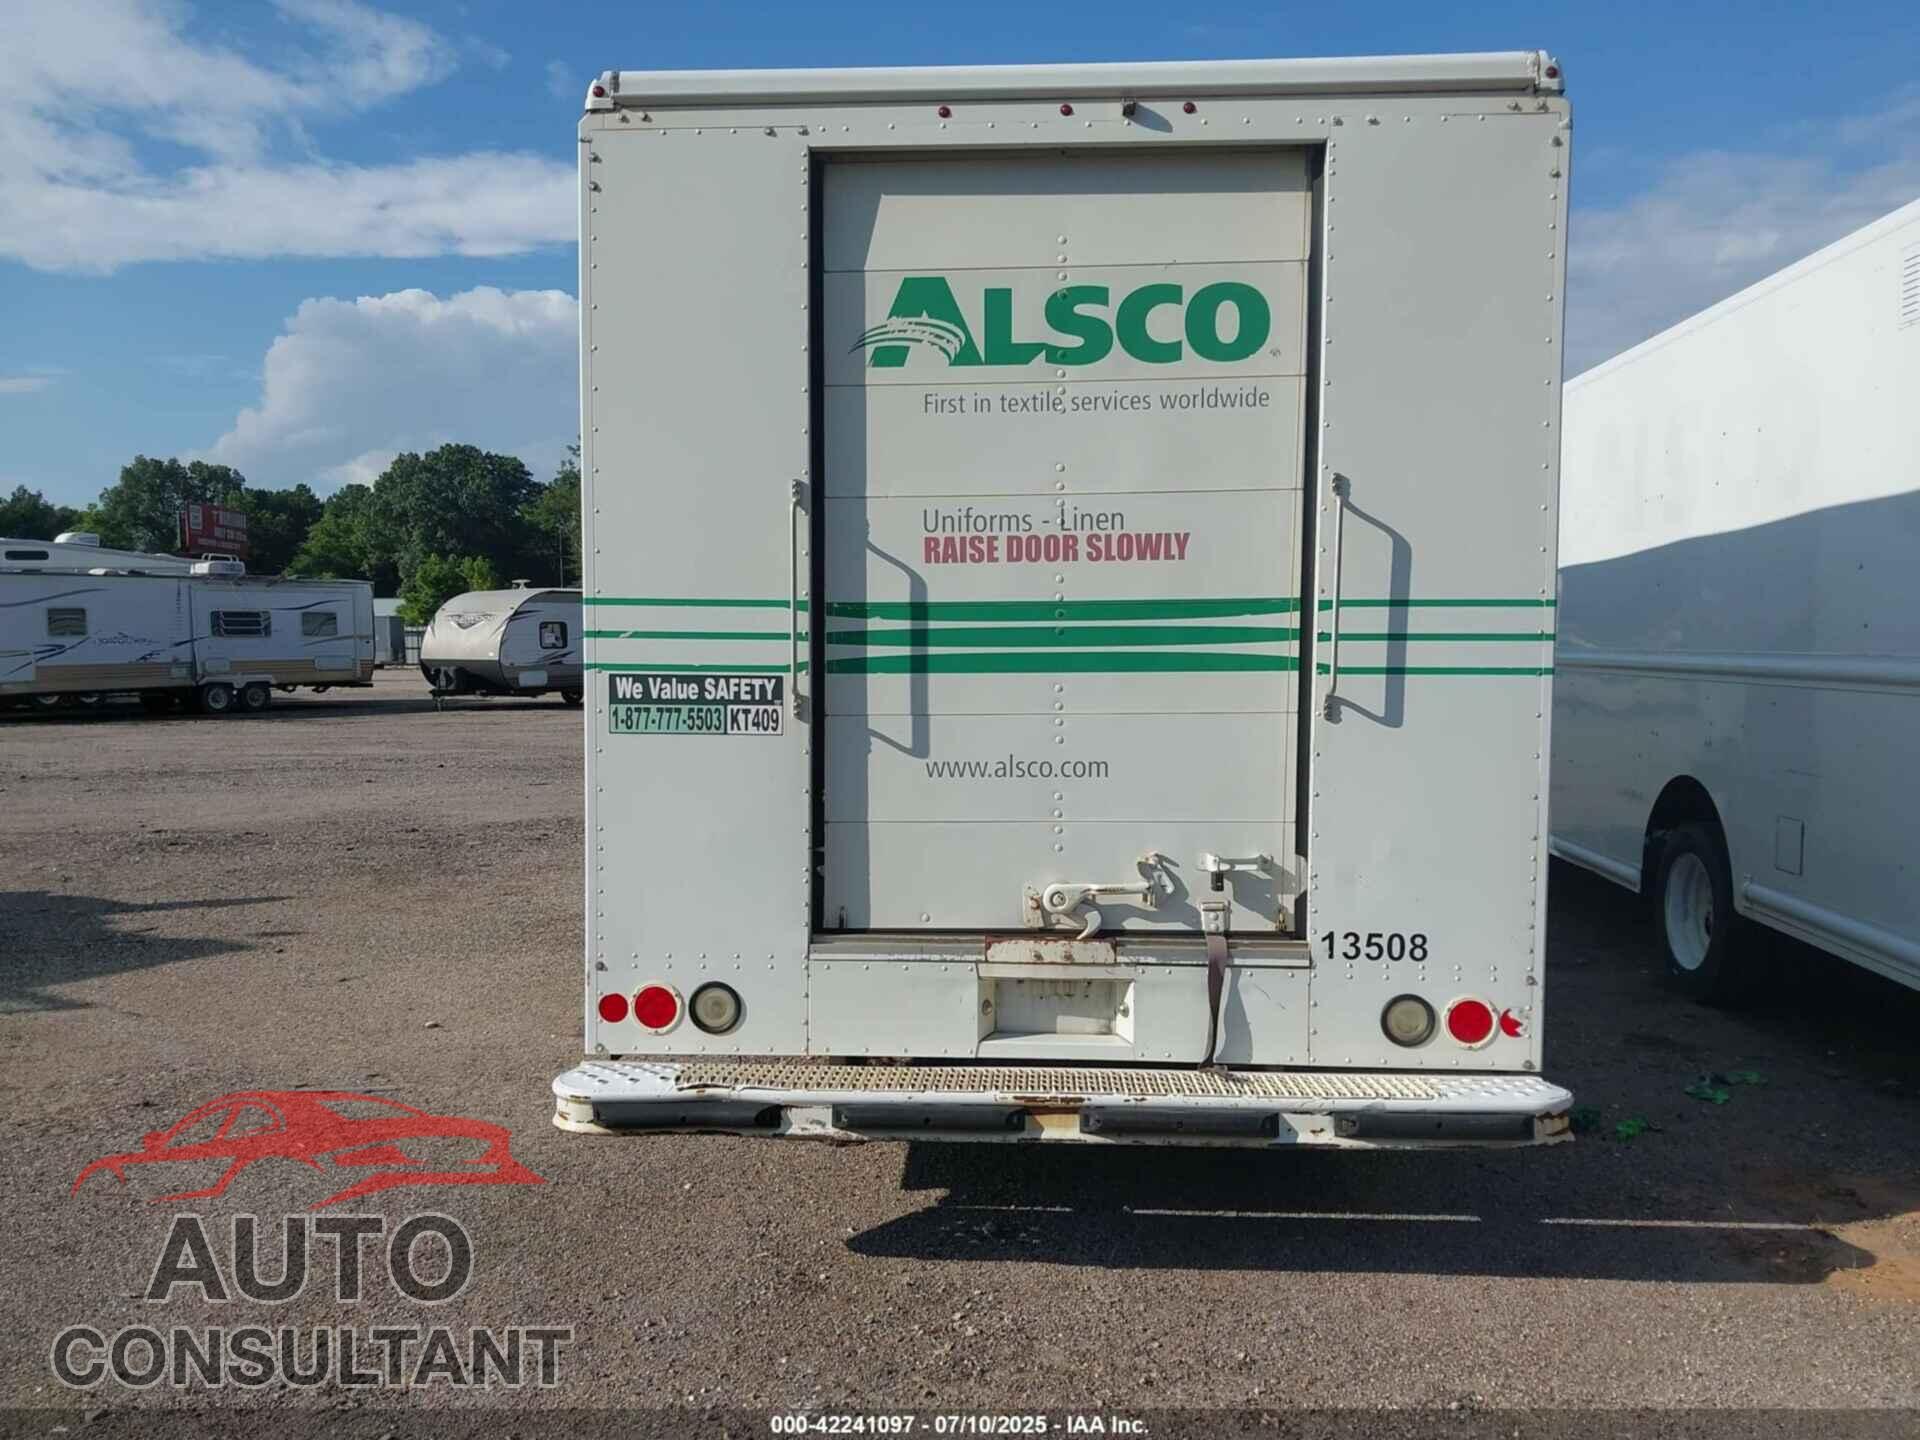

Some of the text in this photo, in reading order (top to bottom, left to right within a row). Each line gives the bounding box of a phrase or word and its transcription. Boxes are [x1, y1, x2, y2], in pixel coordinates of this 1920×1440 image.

[864, 275, 1272, 367] ALSCO
[923, 386, 1271, 415] First in textile services worldwide
[923, 507, 1033, 533] Uniforms
[1059, 505, 1125, 532] Linen
[924, 532, 1190, 564] RAISE DOOR SLOWLY
[615, 677, 776, 701] We Value SAFETY
[612, 707, 780, 732] 1-877-777-5503 KT409
[926, 754, 1109, 779] www.alsco.com
[1320, 931, 1429, 962] 13508
